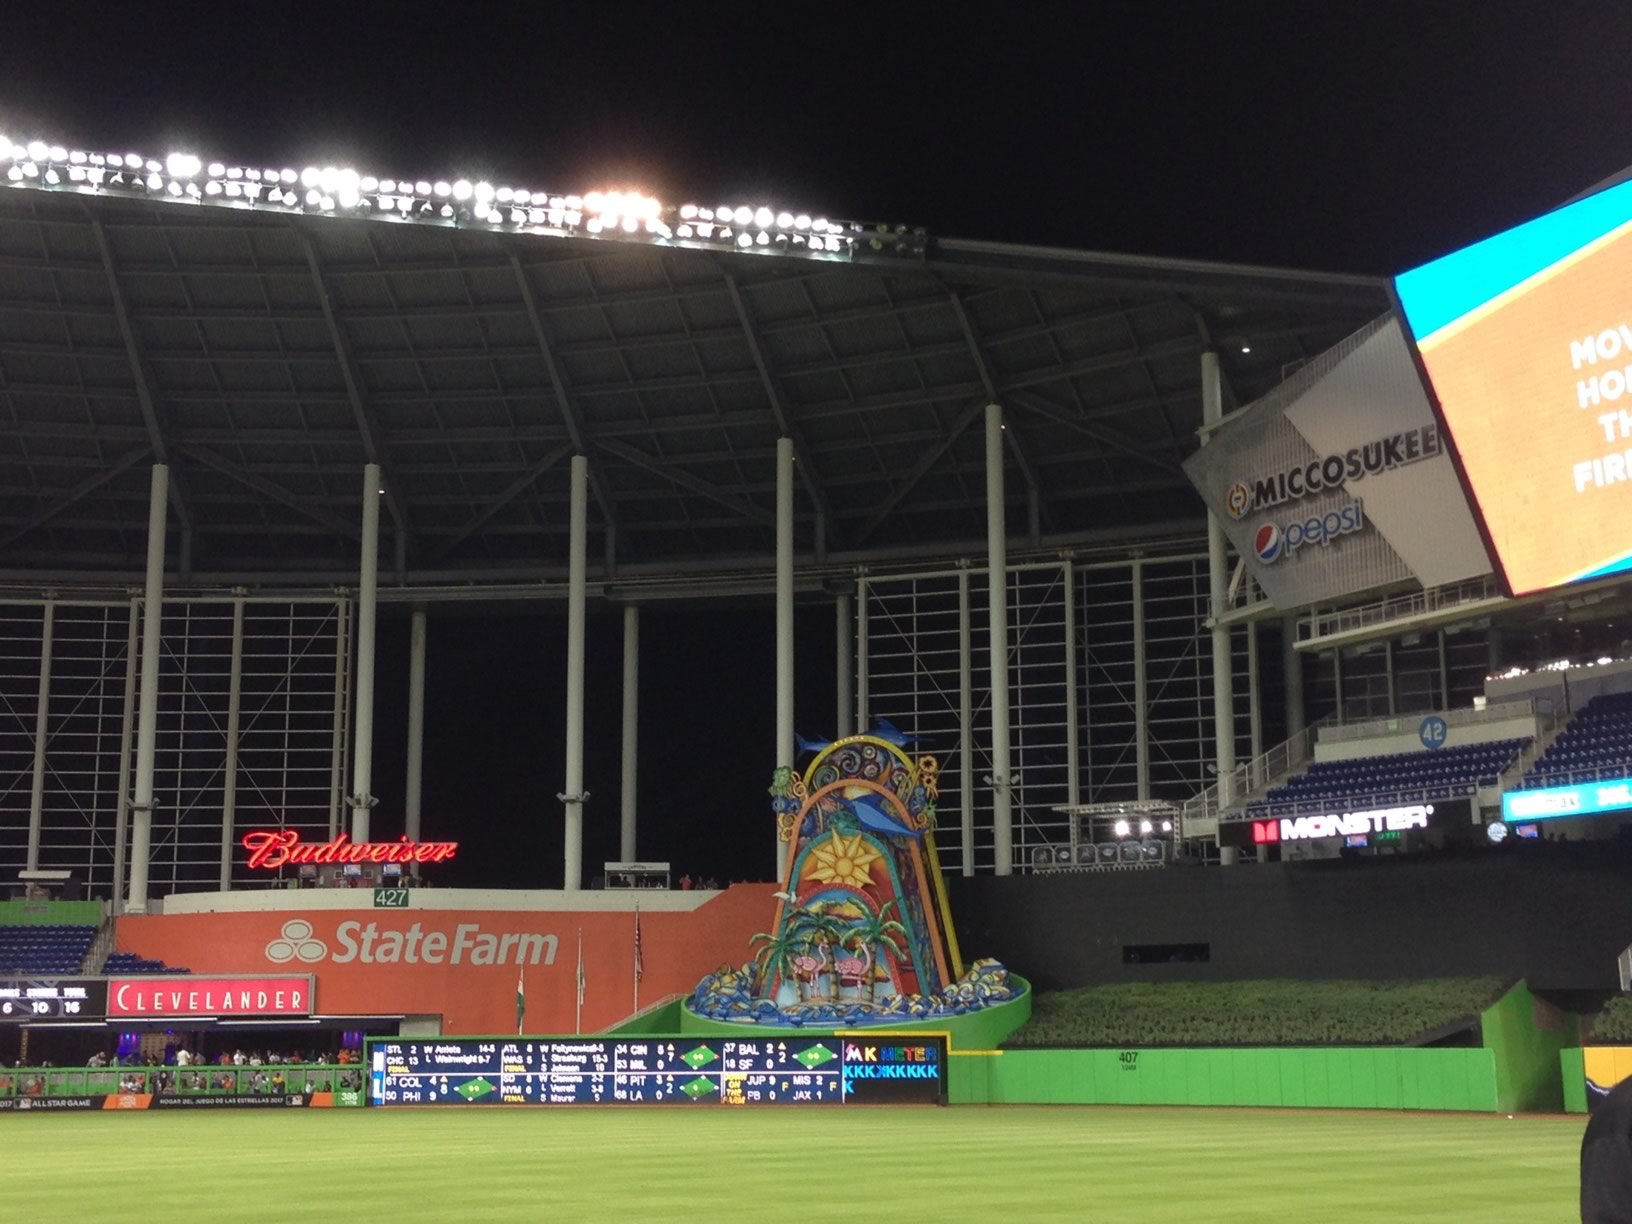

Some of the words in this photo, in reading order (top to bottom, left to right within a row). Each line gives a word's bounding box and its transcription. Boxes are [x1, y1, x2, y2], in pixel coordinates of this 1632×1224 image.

[1254, 424, 1438, 508] MICCOSUKEE
[1573, 447, 1632, 492] FIR
[1284, 499, 1362, 556] pepsi
[1423, 723, 1443, 740] 42
[1280, 805, 1428, 840] MONSTER
[242, 830, 458, 868] Budweiser
[376, 889, 407, 906] 427
[32, 1001, 48, 1013] 10
[387, 1046, 402, 1054] STL
[503, 1045, 518, 1053] ATL
[630, 1045, 647, 1055] CIN
[739, 1044, 759, 1055] BAL
[766, 1043, 773, 1053] 2
[865, 1047, 877, 1061] K
[668, 1052, 674, 1062] 7
[779, 1052, 786, 1062] 2
[1119, 1052, 1138, 1063] 407
[657, 1060, 664, 1070] 0
[739, 1059, 753, 1070] SF
[766, 1059, 774, 1069] 0
[399, 1078, 422, 1087] COL
[429, 1076, 436, 1085] 4
[630, 1076, 646, 1086] PIT
[747, 1076, 766, 1085] JUP
[793, 1076, 811, 1085] MIS
[816, 1076, 823, 1085] 2
[440, 1084, 447, 1094] 8
[666, 1083, 673, 1093] 2
[385, 1092, 396, 1100] 50
[403, 1092, 421, 1101] PHI
[630, 1091, 643, 1101] LA
[656, 1091, 662, 1099] 0
[747, 1091, 760, 1100] PB
[769, 1091, 776, 1100] 0
[793, 1091, 811, 1100] JAX
[817, 1091, 822, 1099] 1
[67, 1099, 91, 1107] GAME
